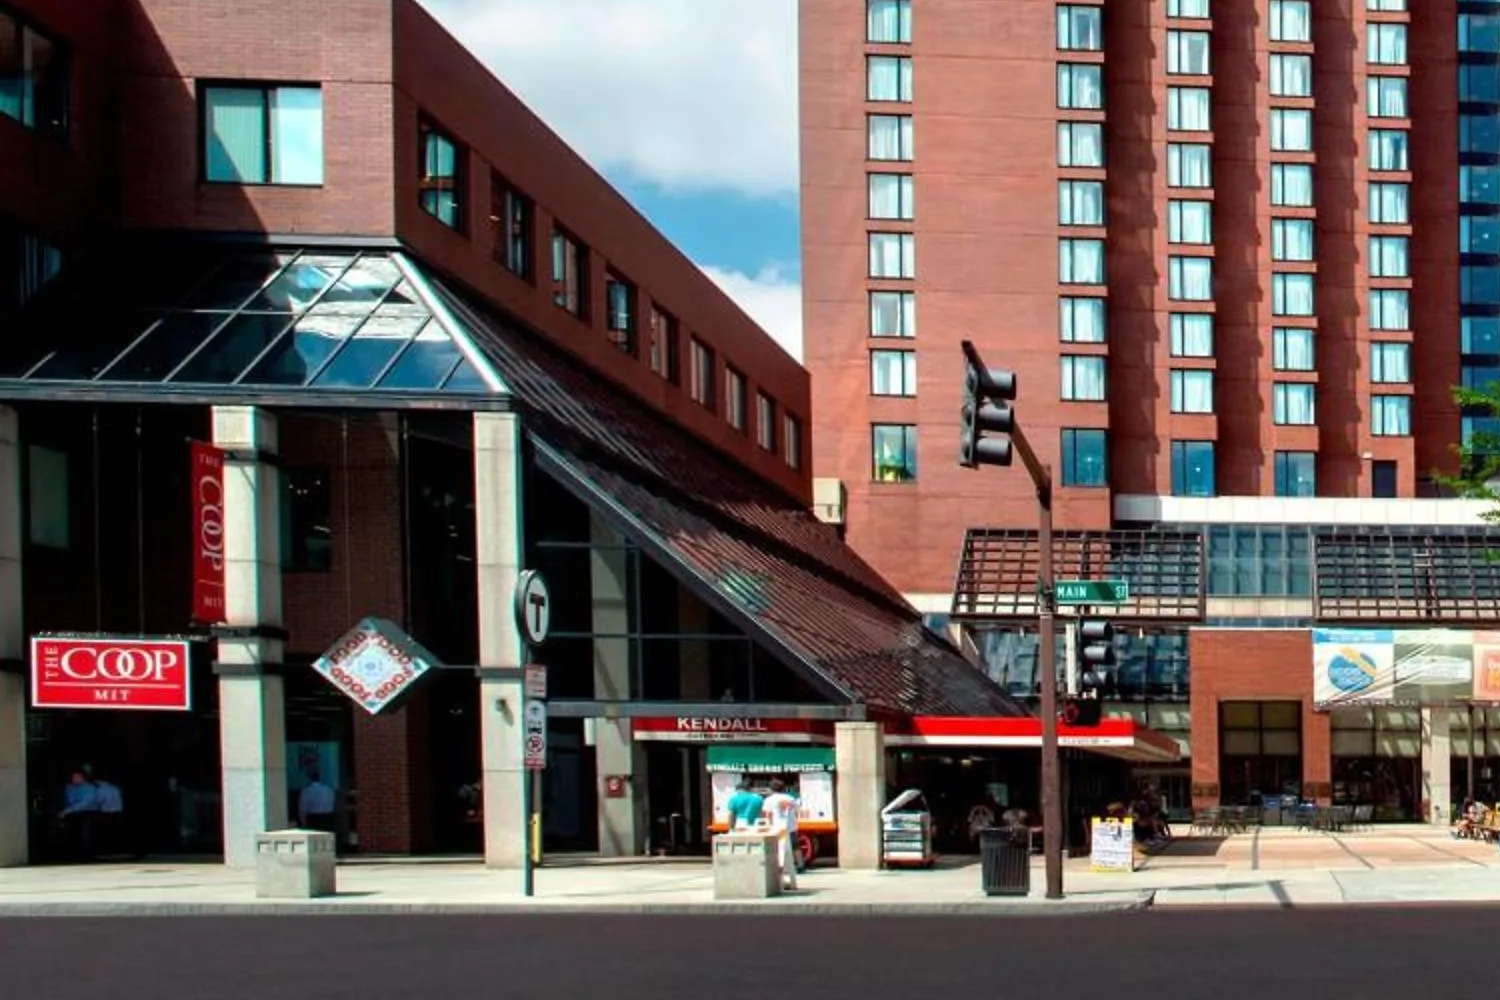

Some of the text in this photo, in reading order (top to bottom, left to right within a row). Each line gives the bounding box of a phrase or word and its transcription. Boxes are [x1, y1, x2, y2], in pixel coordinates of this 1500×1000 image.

[200, 475, 223, 571] COOP
[1057, 585, 1126, 599] MAIN ST
[529, 592, 545, 632] T
[45, 646, 177, 681] THE COOP
[95, 689, 131, 702] MIT
[677, 717, 767, 731] KENDALL
